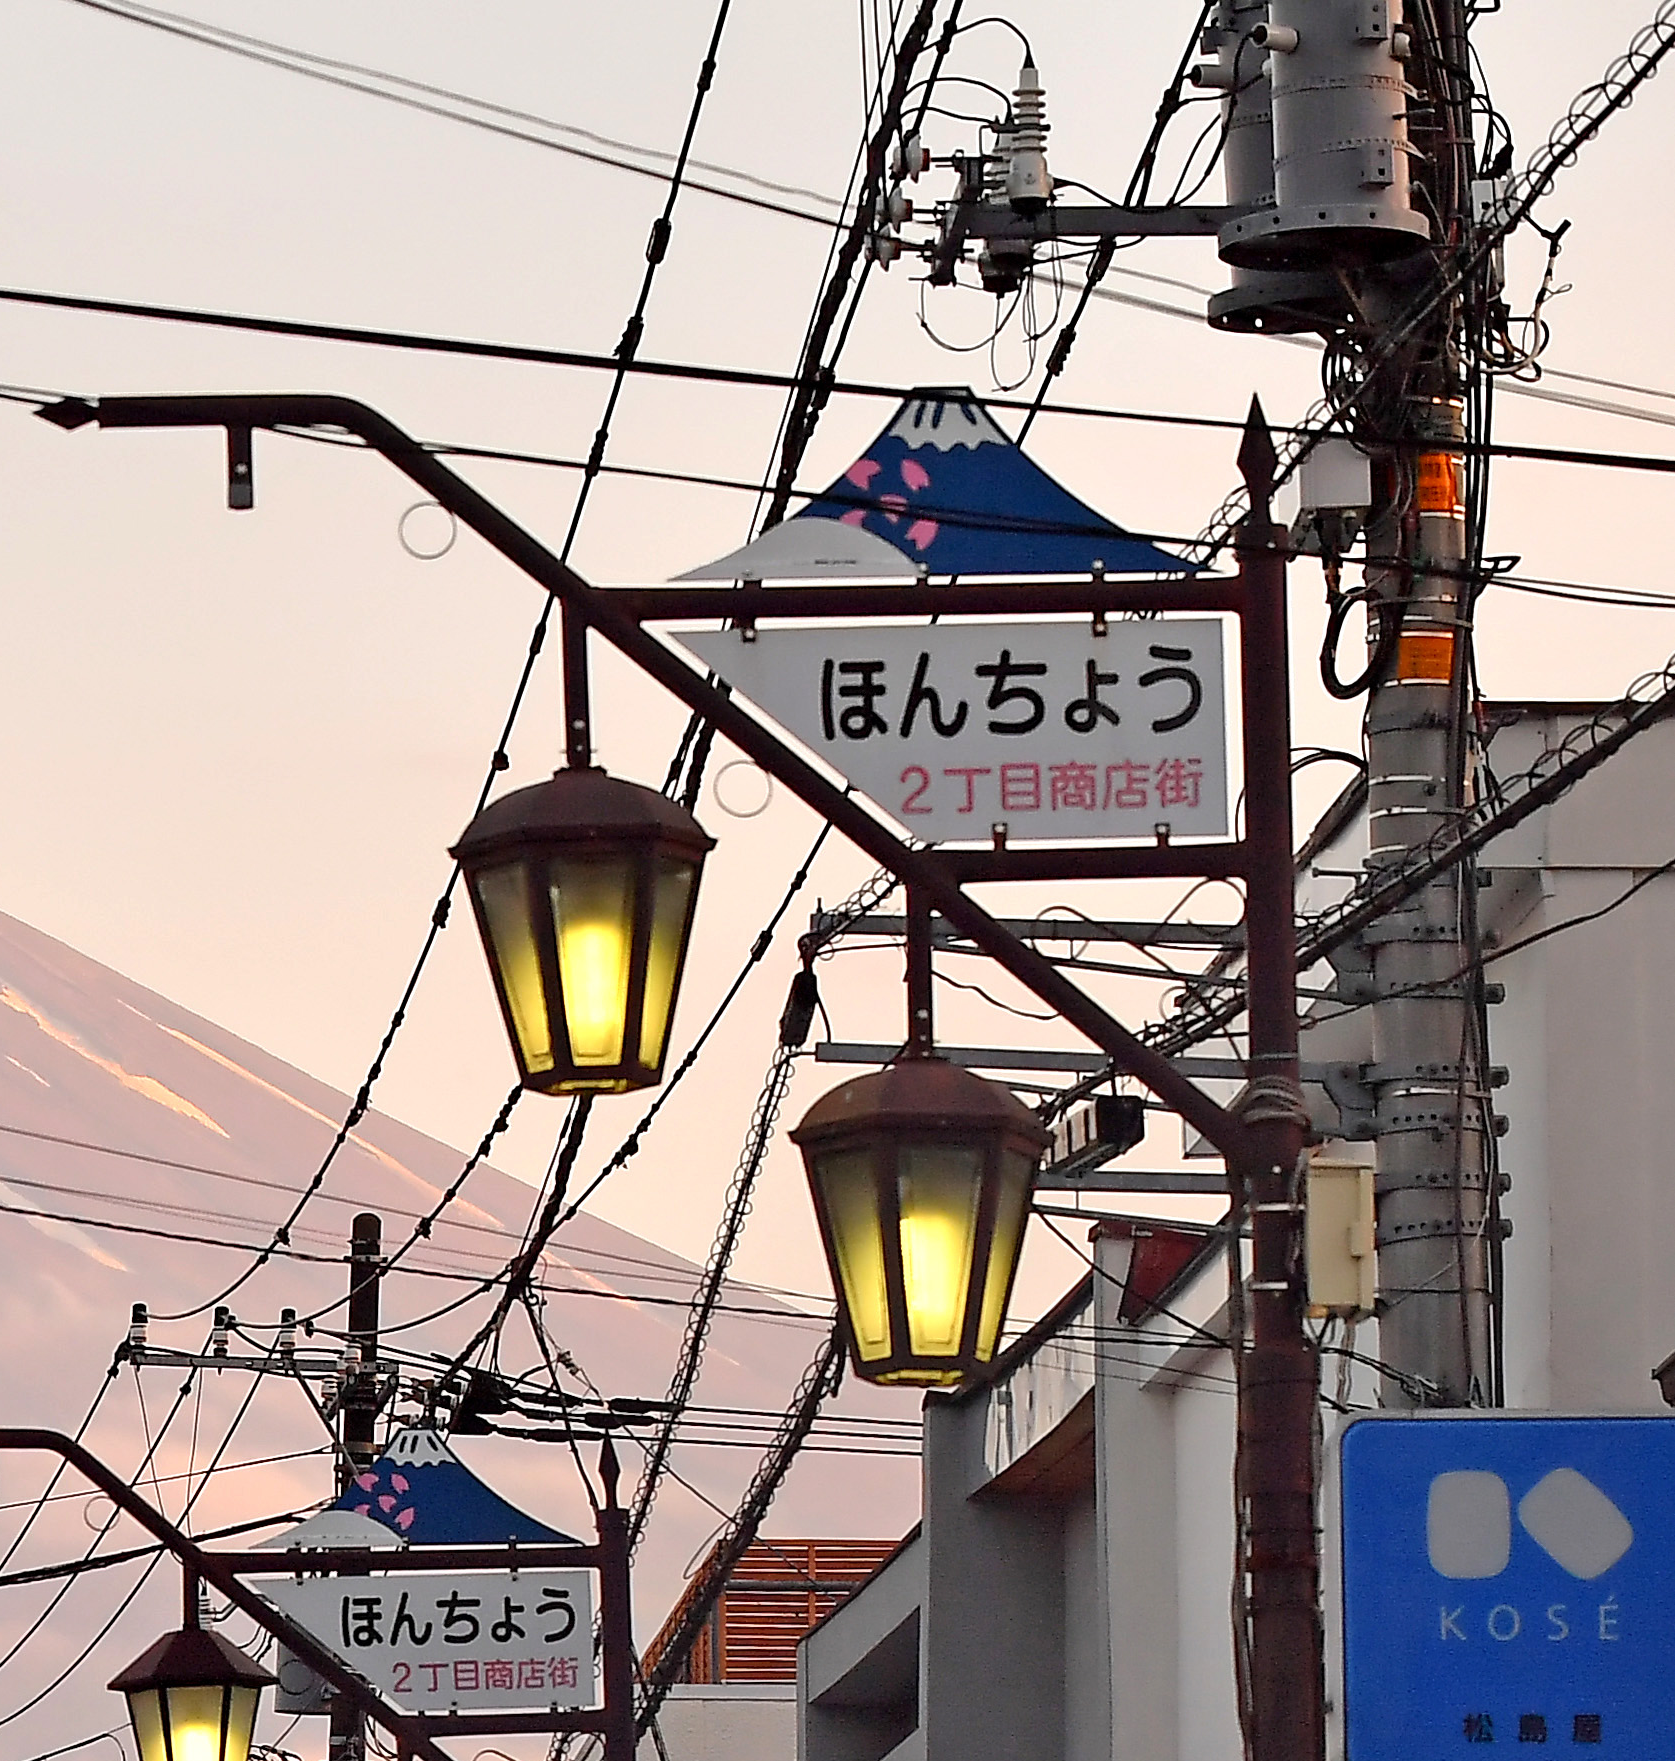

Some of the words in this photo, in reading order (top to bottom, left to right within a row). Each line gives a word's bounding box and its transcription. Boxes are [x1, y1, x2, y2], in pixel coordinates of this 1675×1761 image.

[819, 645, 1203, 742] ほんちょう
[899, 757, 1204, 815] 2丁目商店街
[340, 1586, 577, 1647] ほんちょう
[1440, 1595, 1620, 1642] KOSÉ
[391, 1657, 579, 1694] 2丁目商店街
